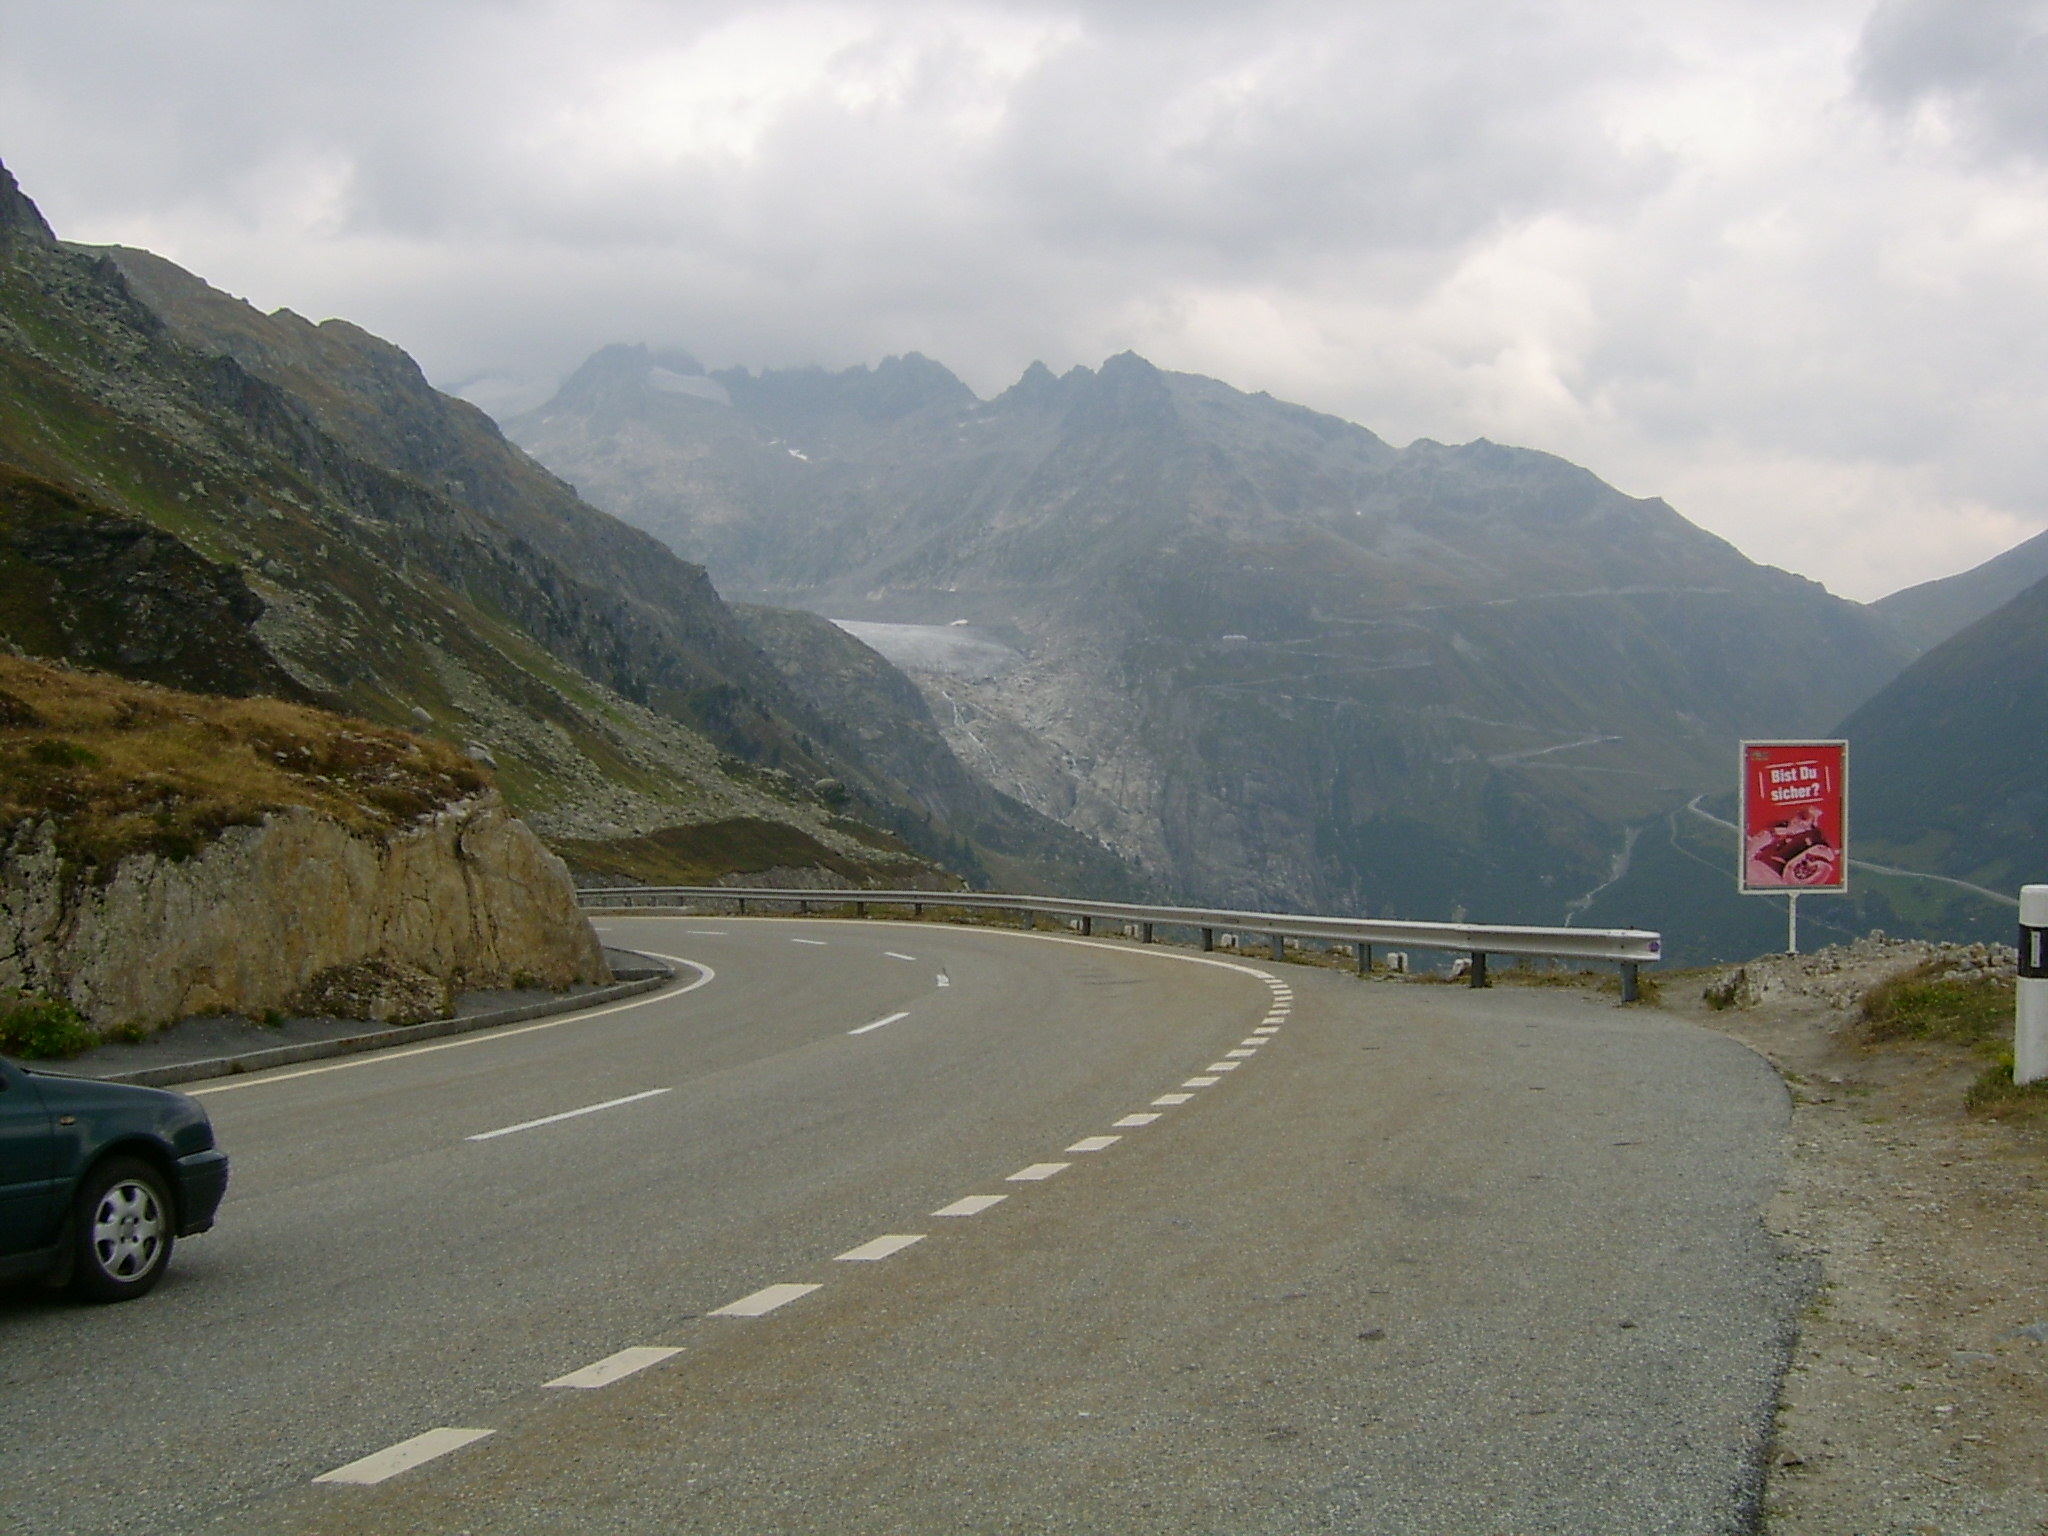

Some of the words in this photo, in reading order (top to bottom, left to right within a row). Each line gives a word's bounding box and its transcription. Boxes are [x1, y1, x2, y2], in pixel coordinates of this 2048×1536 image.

[1771, 768, 1797, 784] Bist
[1799, 766, 1817, 781] Du
[1770, 782, 1820, 801] sicher?
